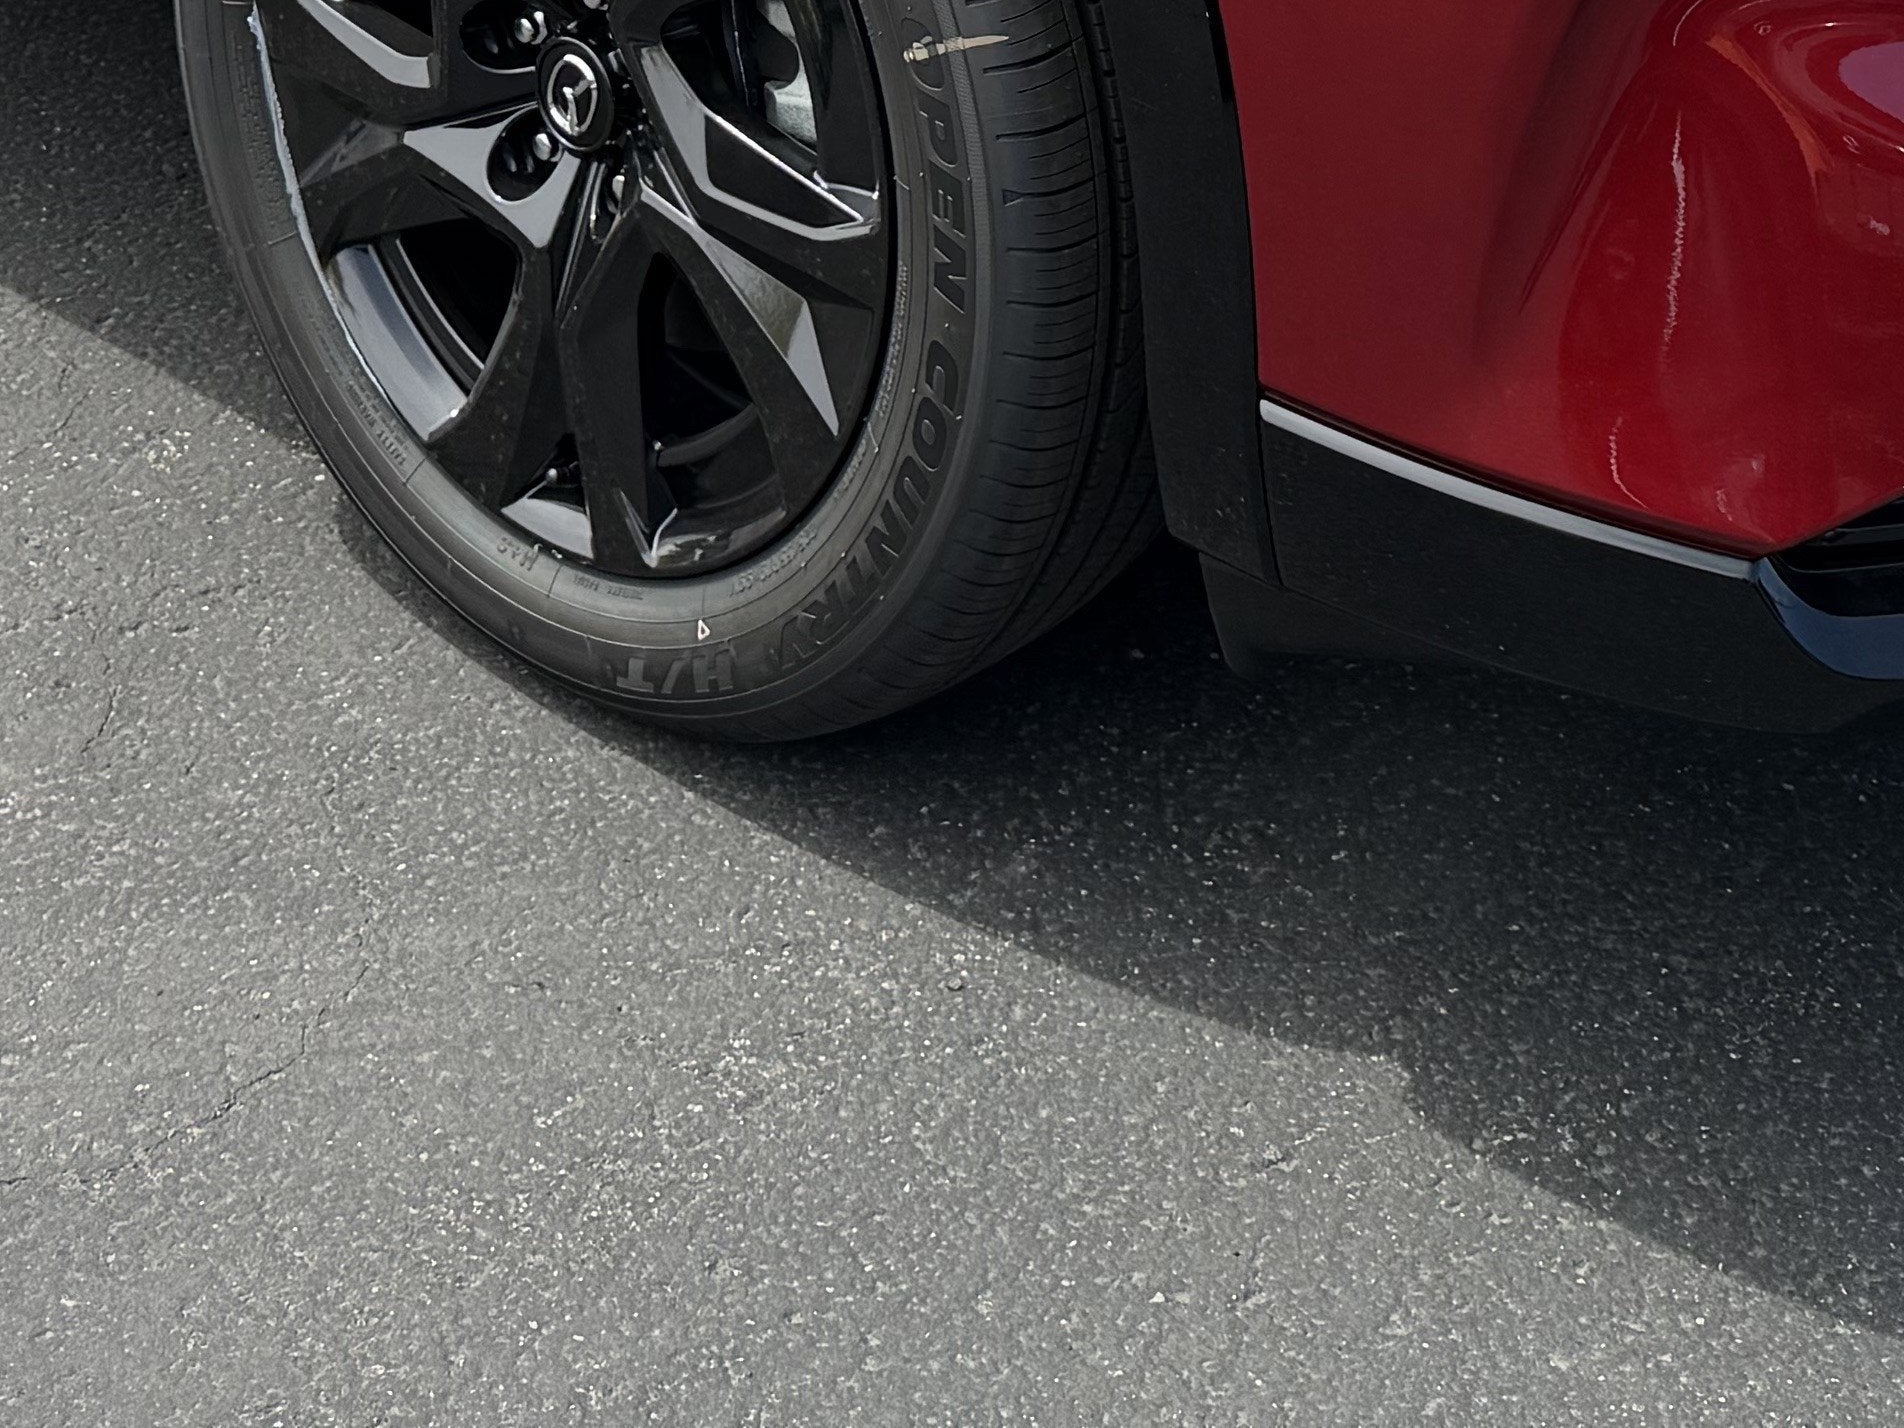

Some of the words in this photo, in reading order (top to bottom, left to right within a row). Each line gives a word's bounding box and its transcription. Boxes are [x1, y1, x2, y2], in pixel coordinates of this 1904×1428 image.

[900, 17, 968, 314] OPEN
[779, 338, 959, 669] COUNTRY
[615, 646, 736, 694] H/T
